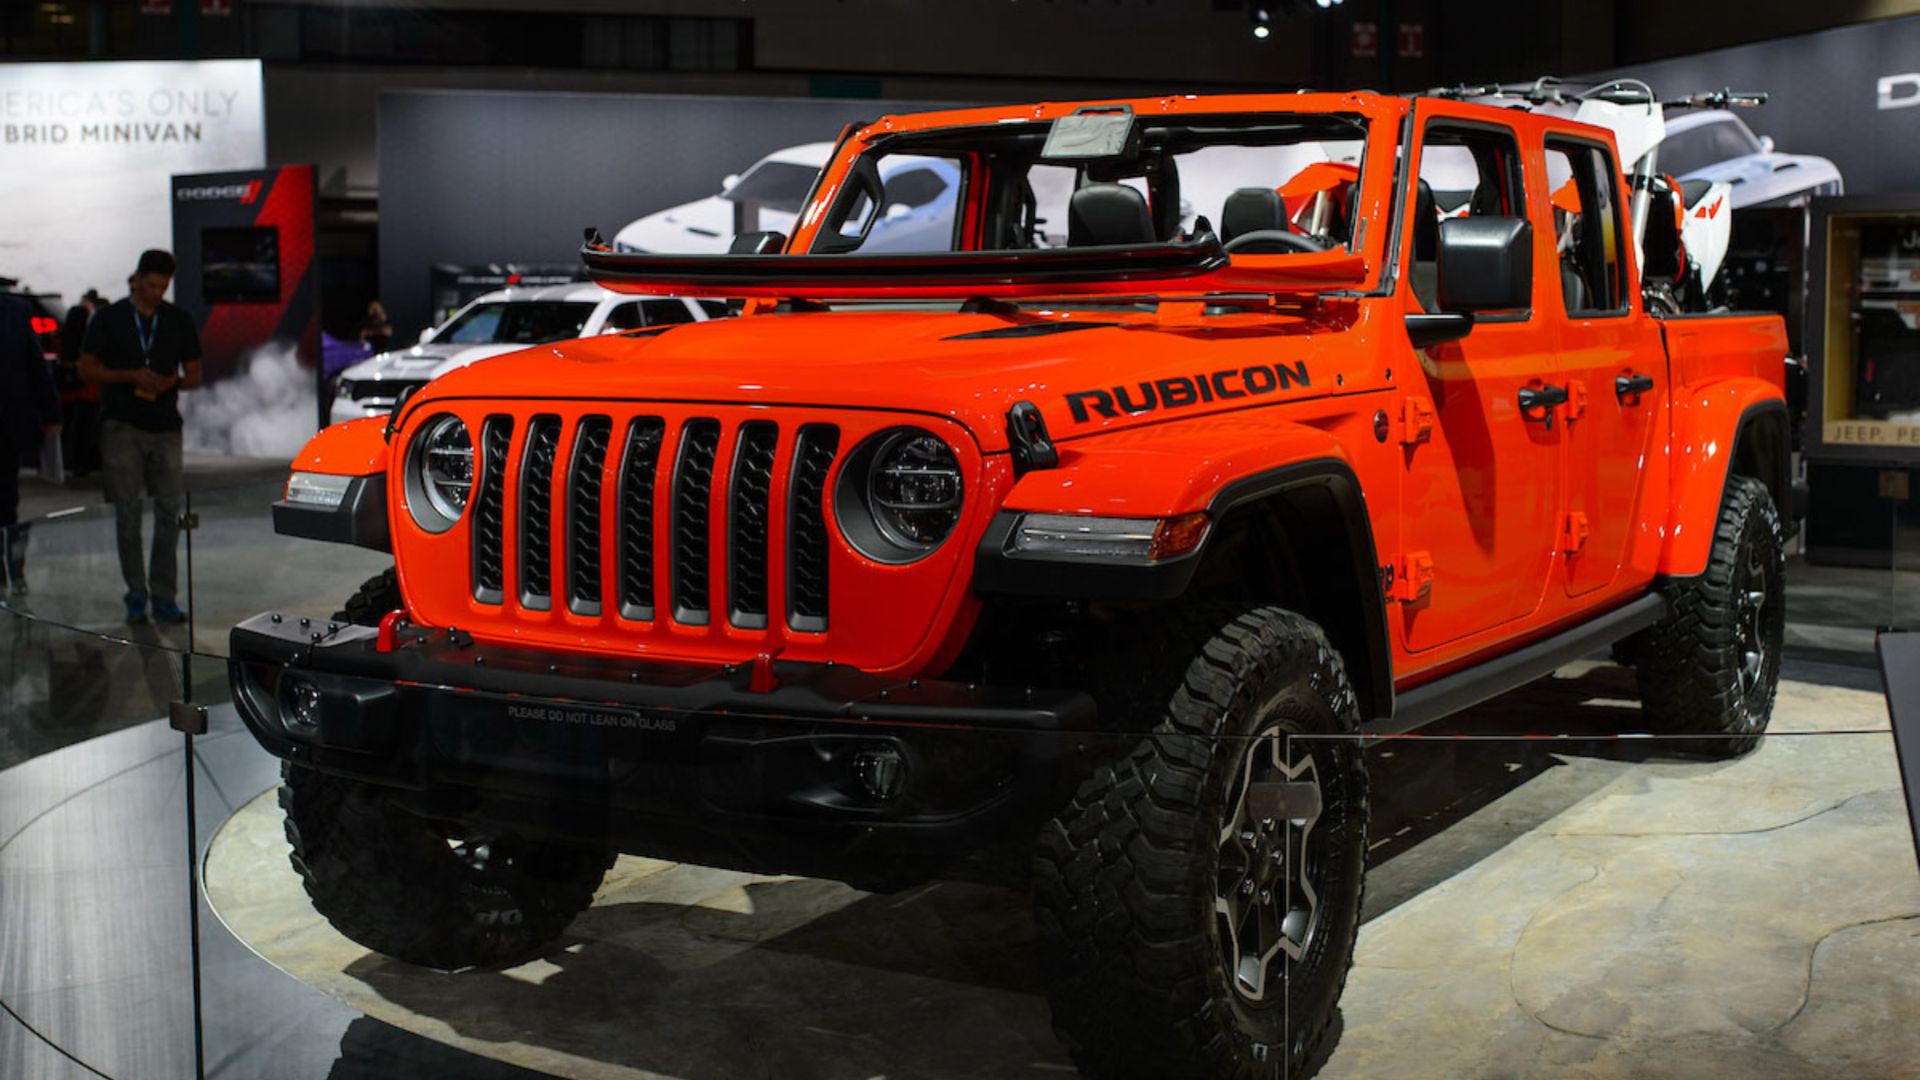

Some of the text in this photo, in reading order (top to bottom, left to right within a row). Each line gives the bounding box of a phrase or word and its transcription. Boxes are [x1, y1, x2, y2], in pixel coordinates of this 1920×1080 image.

[0, 88, 239, 118] ERICA'S ONLY
[81, 121, 203, 144] MINIVAN
[177, 184, 251, 200] DODGE
[1063, 360, 1311, 424] RUBICON
[508, 705, 676, 731] PLEASE DO NOT LEAN ON GLASS
